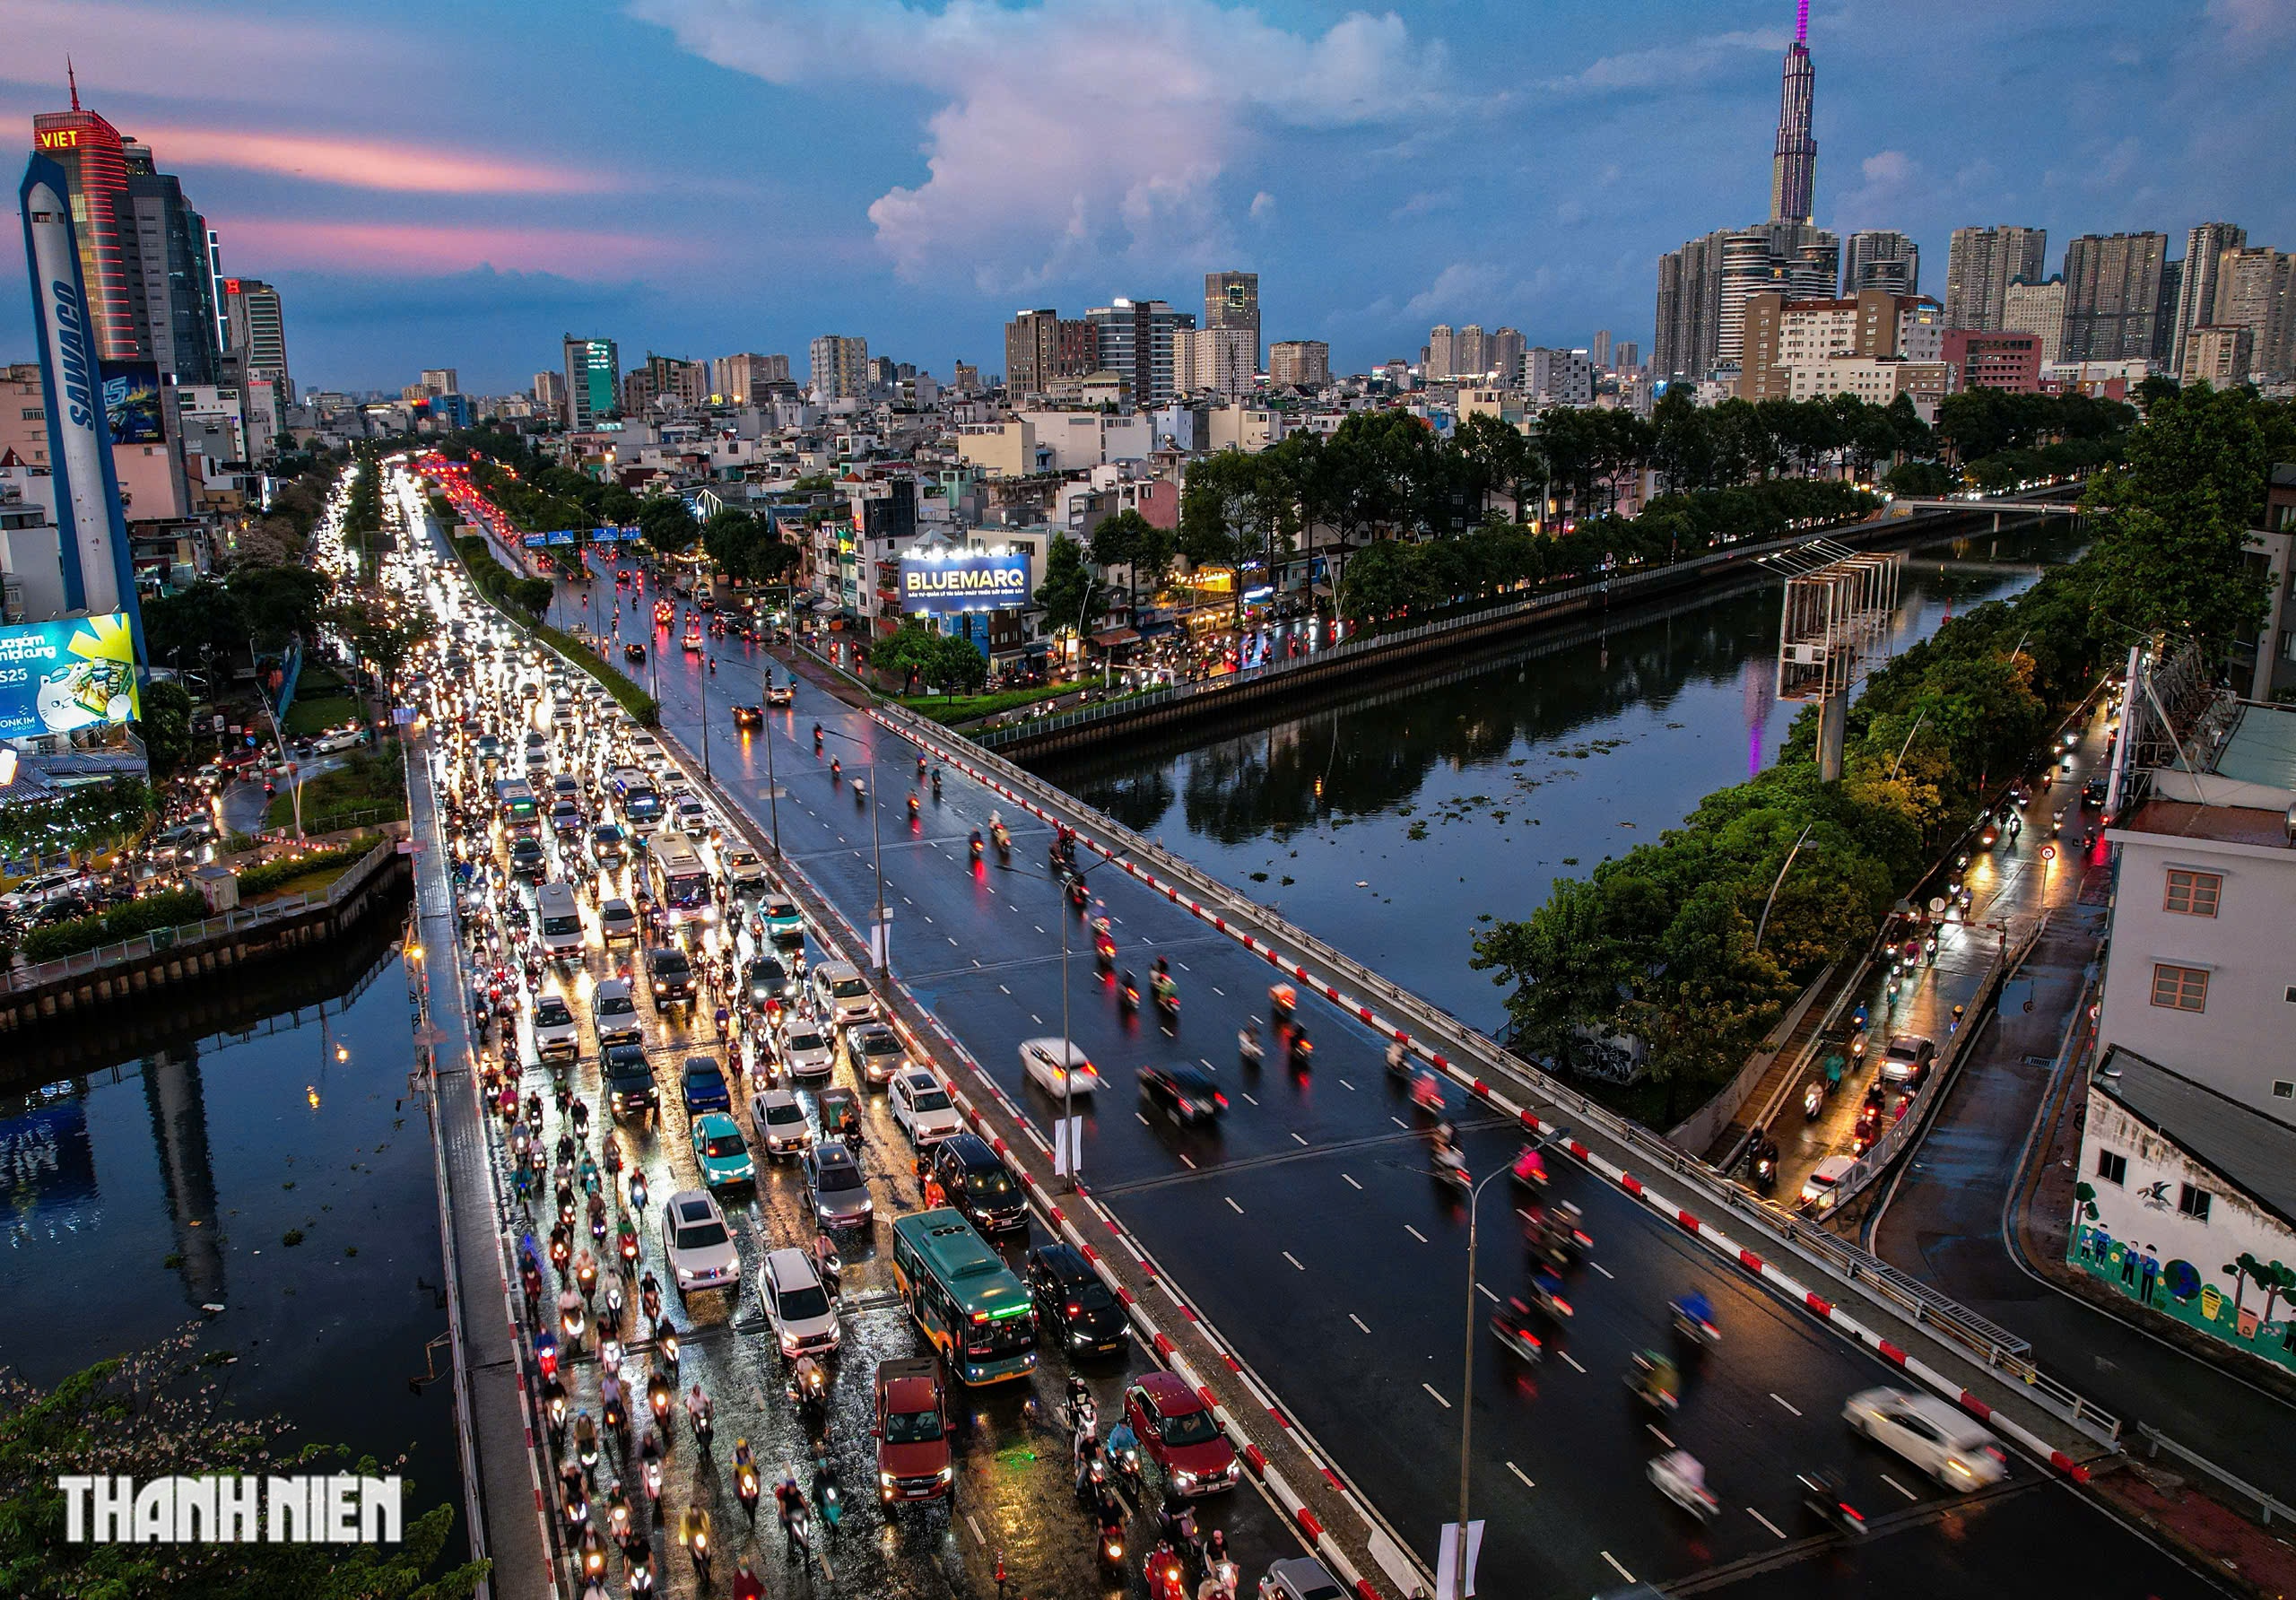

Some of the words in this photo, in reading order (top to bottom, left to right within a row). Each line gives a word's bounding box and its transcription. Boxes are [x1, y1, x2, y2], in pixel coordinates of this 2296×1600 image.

[40, 130, 78, 148] VIET
[52, 280, 94, 431] SAWACO
[907, 569, 1024, 590] BLUEMARQ
